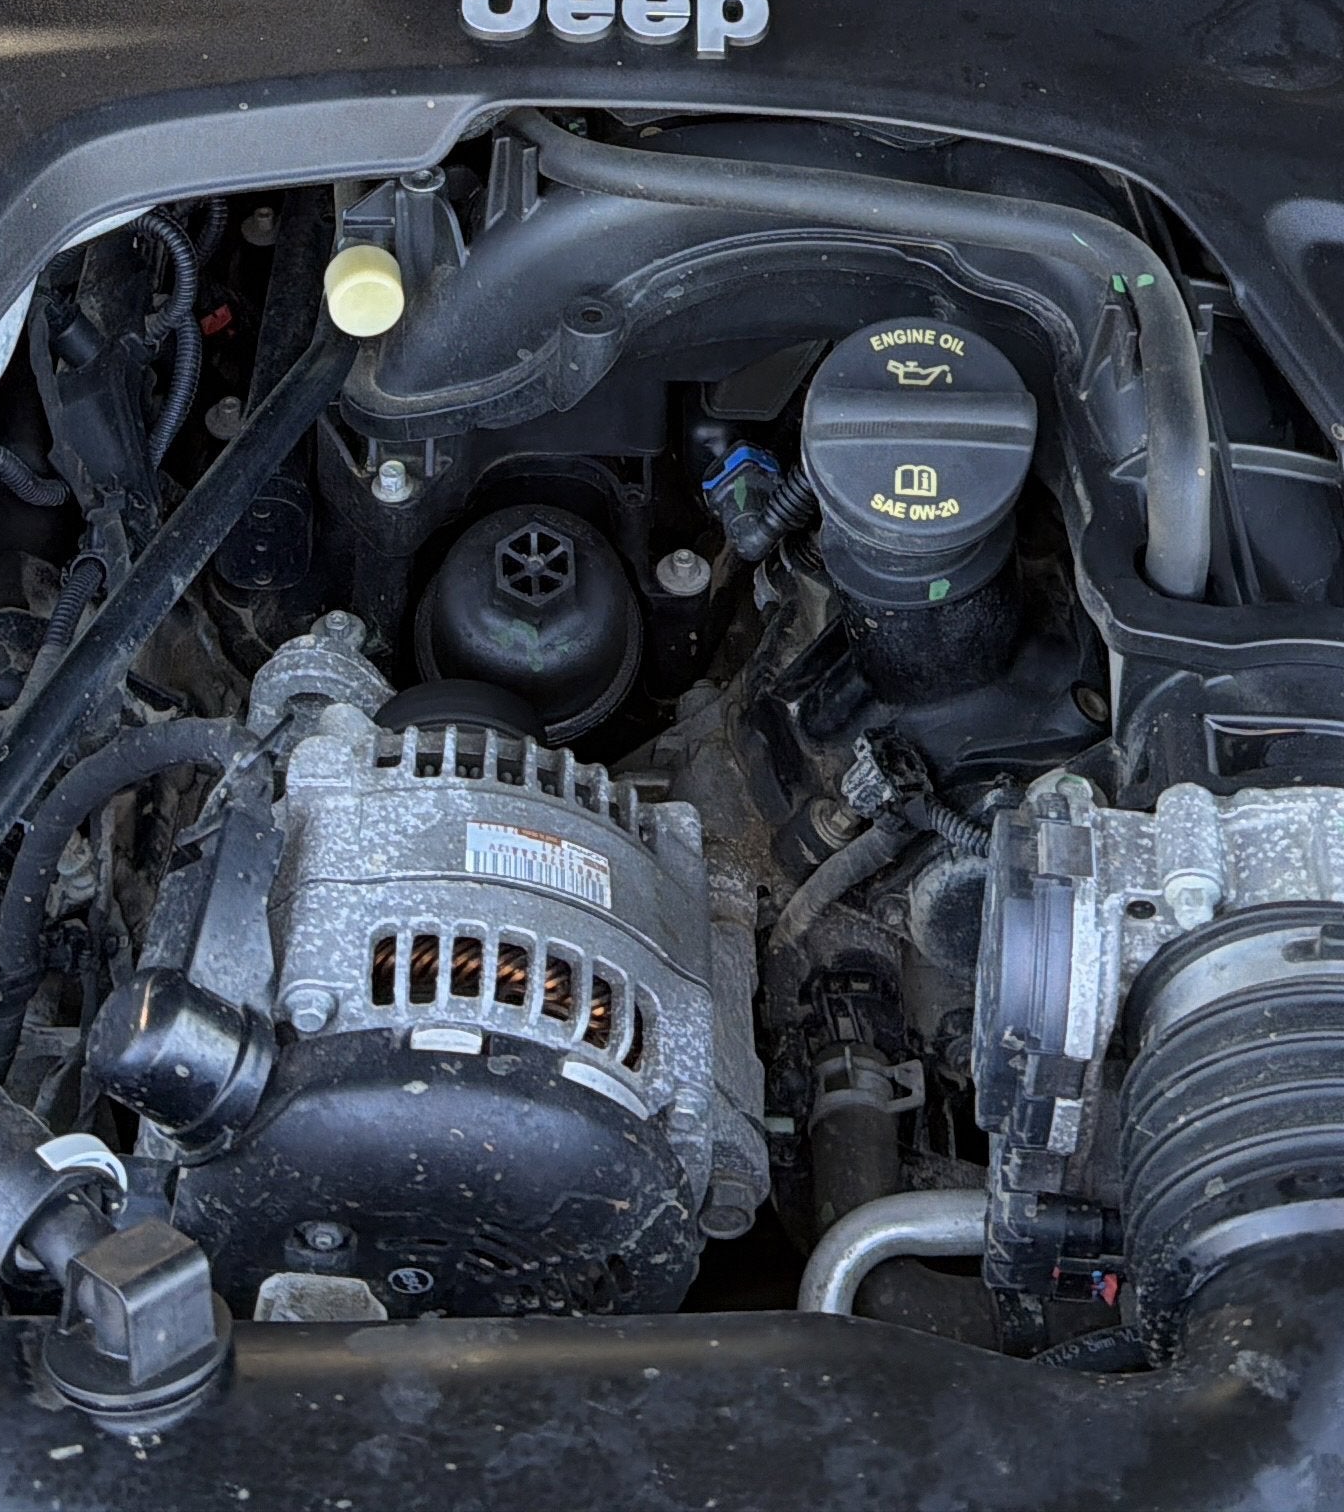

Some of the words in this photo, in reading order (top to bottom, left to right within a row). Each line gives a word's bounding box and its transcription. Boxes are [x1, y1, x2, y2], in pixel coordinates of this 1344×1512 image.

[869, 328, 937, 352] ENGINE
[939, 333, 965, 357] OIL
[870, 492, 906, 519] SAE
[909, 497, 960, 521] 0W-20
